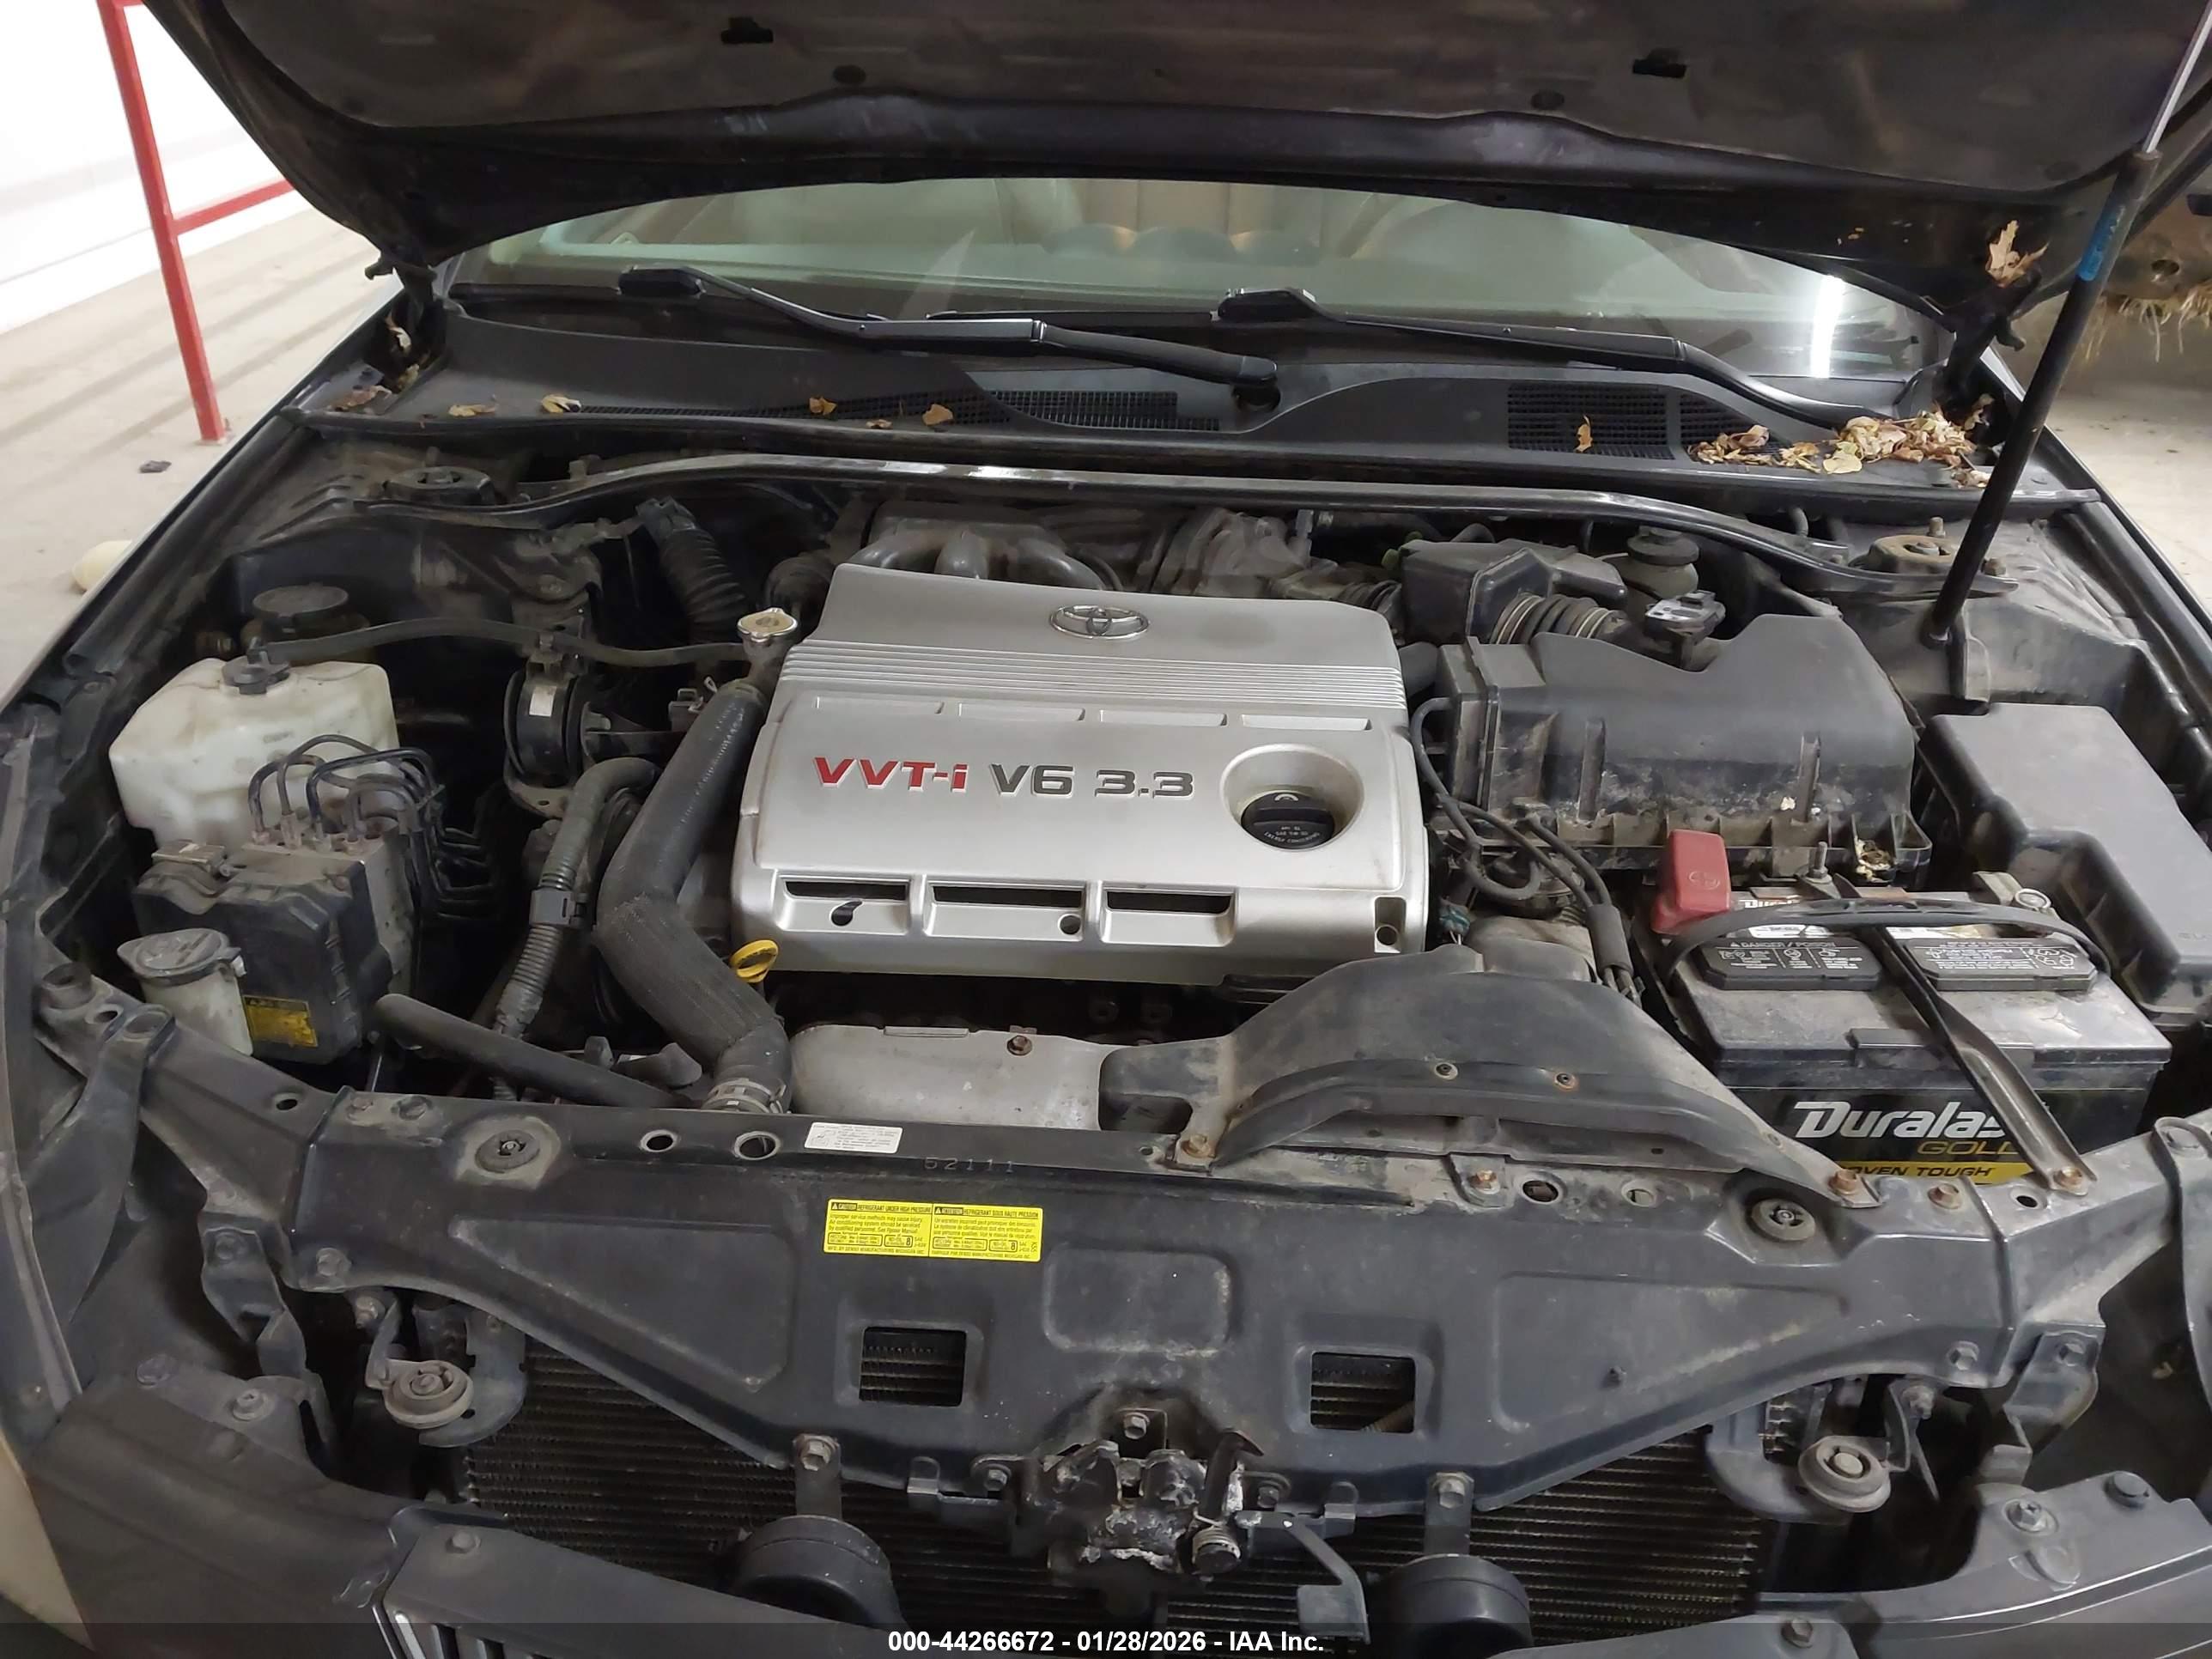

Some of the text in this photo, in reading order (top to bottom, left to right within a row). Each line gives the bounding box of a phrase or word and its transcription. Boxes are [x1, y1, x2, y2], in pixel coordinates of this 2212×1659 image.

[814, 757, 1194, 799] VVT-i V6 3.3
[1794, 1101, 2006, 1139] Duralas
[924, 1157, 1013, 1173] 52111
[1844, 1166, 1994, 1177] OVEN TOUGH
